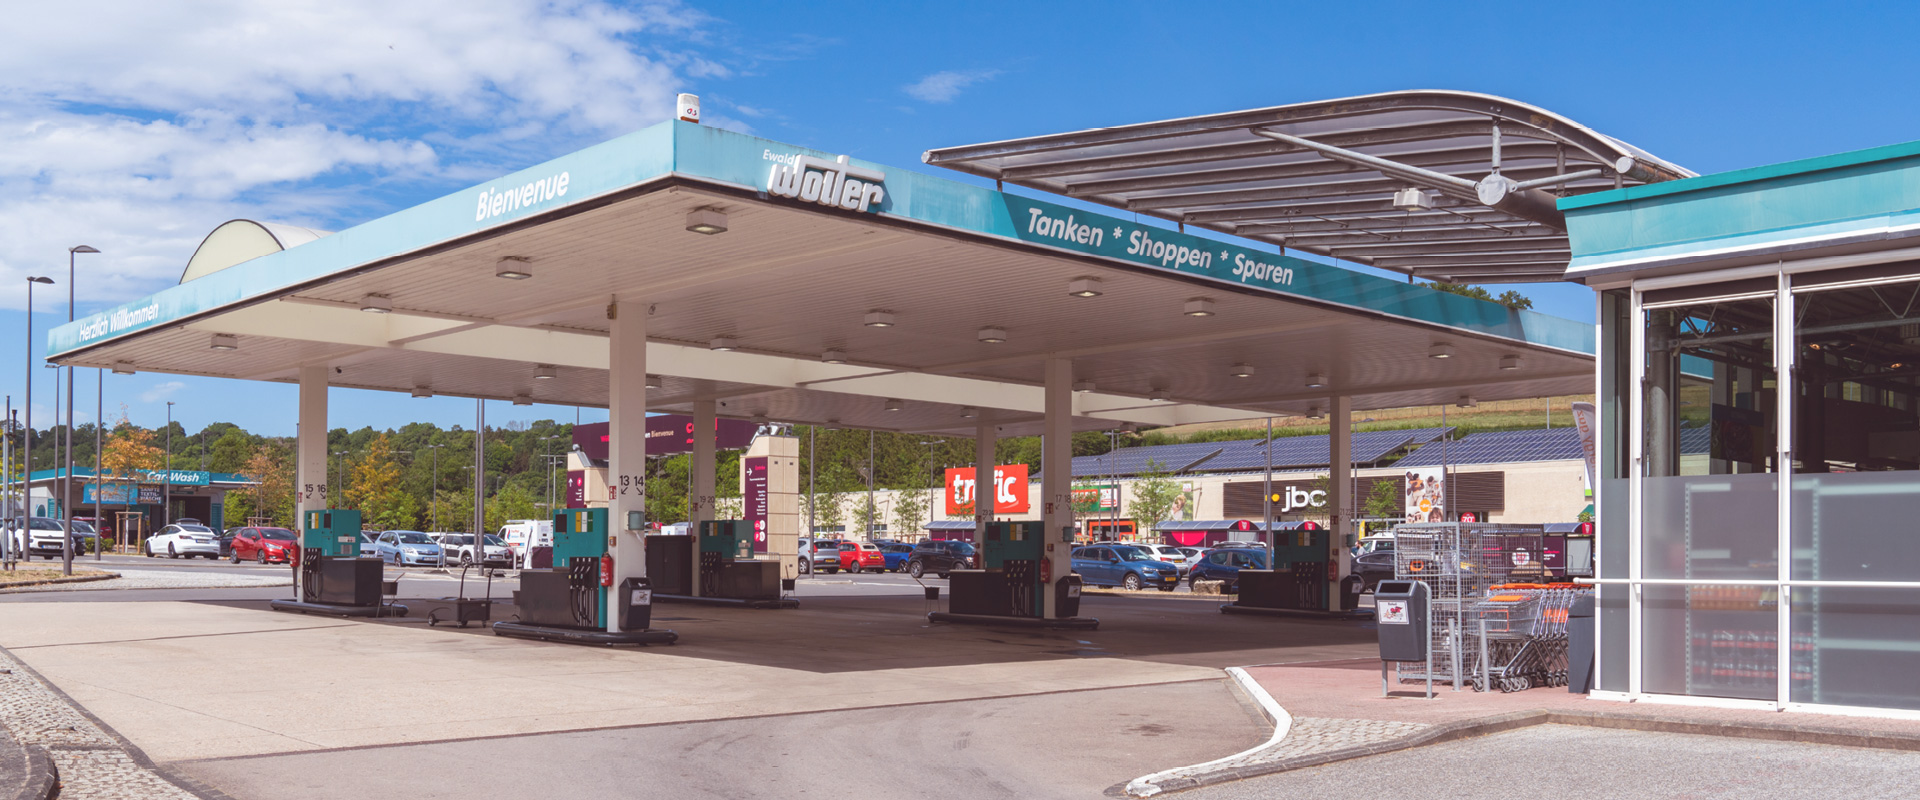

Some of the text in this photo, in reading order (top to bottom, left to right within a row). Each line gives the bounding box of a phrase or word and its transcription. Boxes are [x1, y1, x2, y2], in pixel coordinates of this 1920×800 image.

[762, 149, 795, 165] Ewald
[475, 171, 570, 222] Bienvenue
[1028, 207, 1294, 286] Tanken Shoppen Sparen
[79, 303, 159, 343] Herzlich Willkommen
[651, 430, 674, 438] Bienvenue
[147, 472, 199, 482] Car-Wash
[619, 475, 629, 487] 13
[633, 476, 644, 487] 14
[305, 484, 314, 492] 15
[317, 485, 326, 493] 16
[953, 469, 1017, 505] tric
[708, 496, 715, 504] 20
[1056, 495, 1062, 503] 17
[1065, 495, 1071, 503] 18
[1281, 486, 1327, 512] jbc
